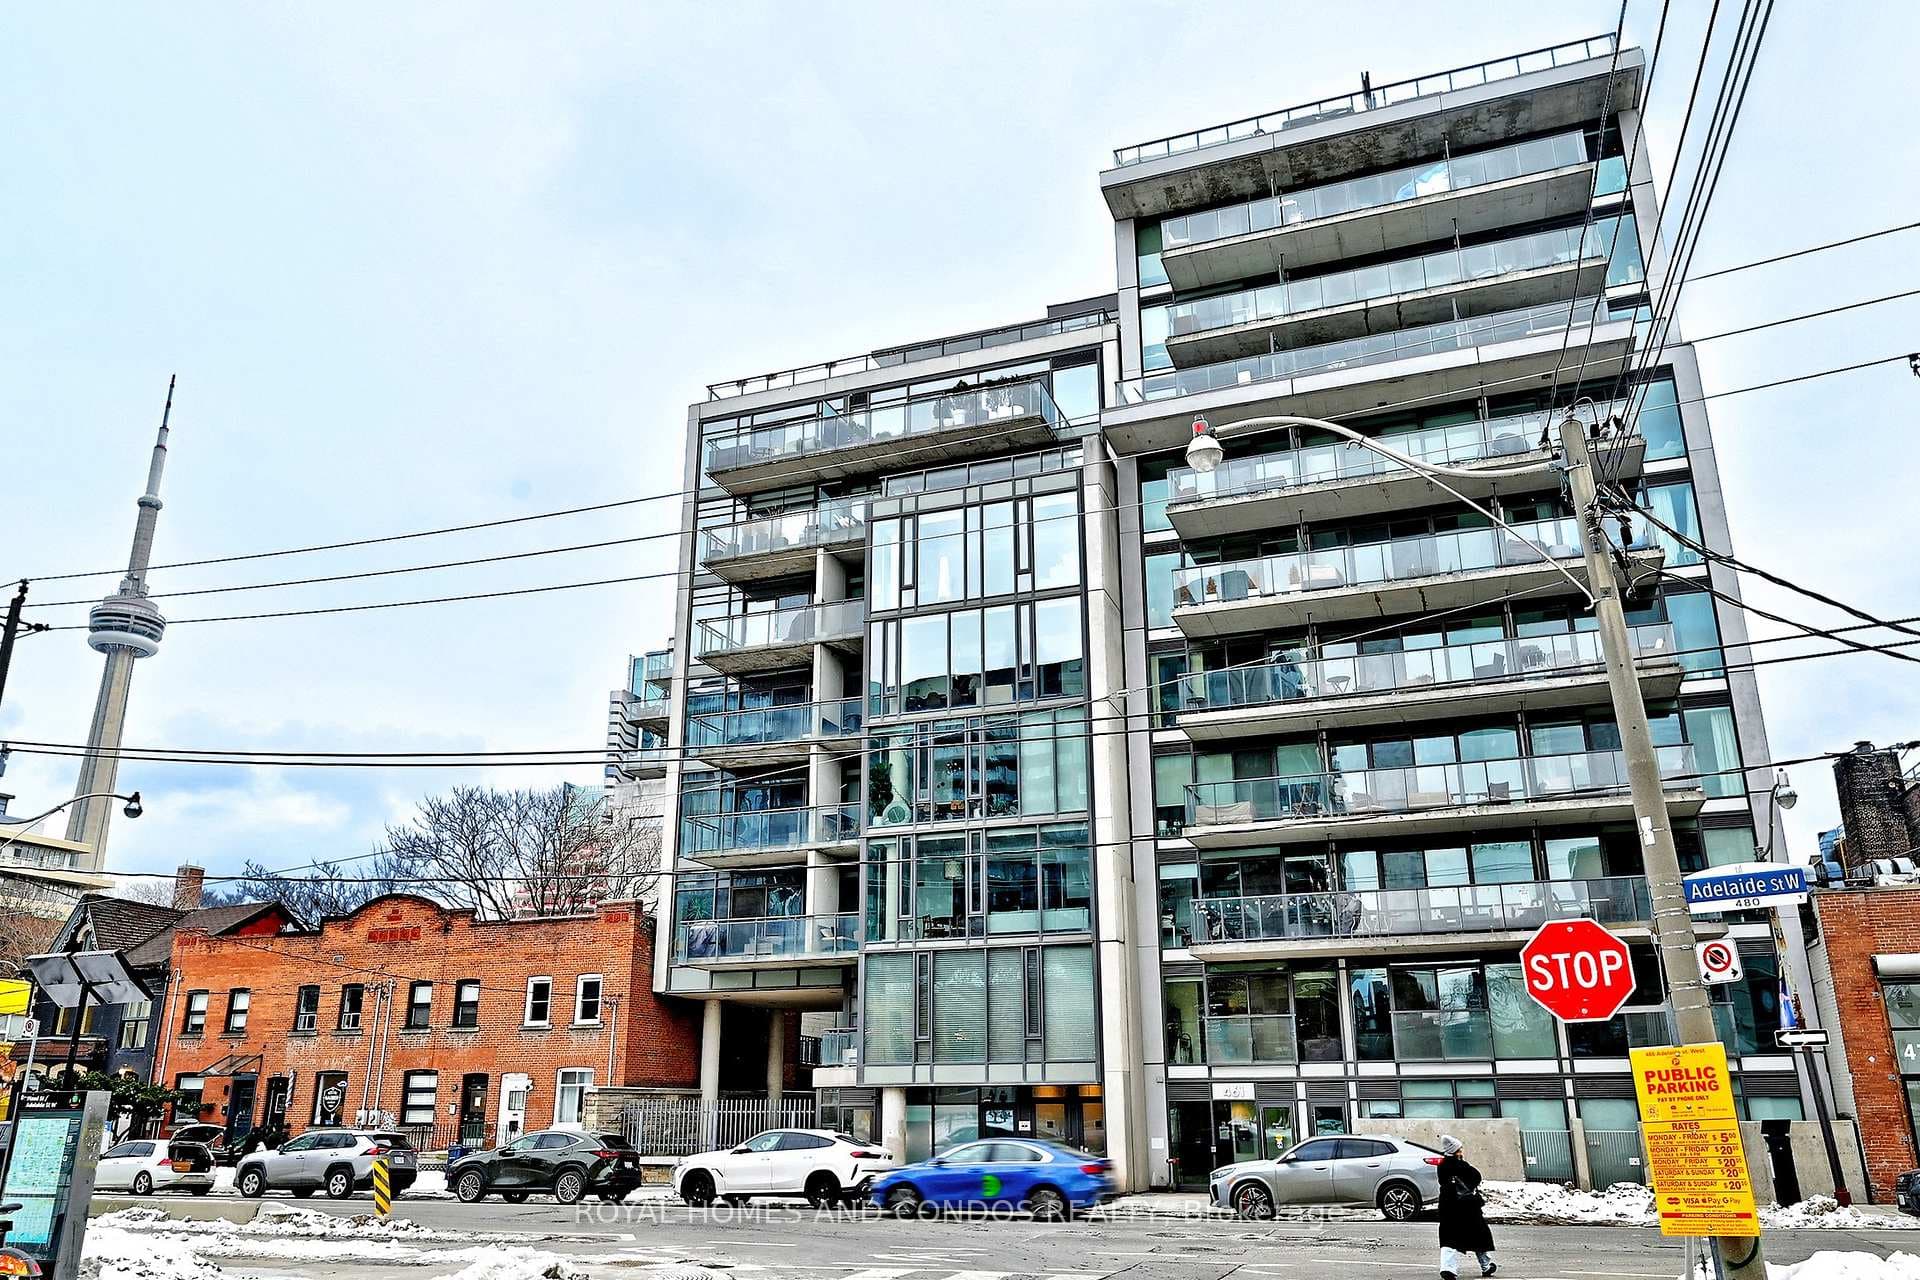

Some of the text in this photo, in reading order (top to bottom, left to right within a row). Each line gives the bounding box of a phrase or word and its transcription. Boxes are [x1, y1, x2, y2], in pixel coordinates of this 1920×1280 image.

[1692, 873, 1800, 899] Adelaide St W
[1736, 898, 1760, 907] 480
[1530, 950, 1623, 991] STOP
[1903, 1043, 1920, 1060] 4
[1645, 1066, 1717, 1082] PUBLIC
[1224, 1086, 1246, 1098] 461
[1647, 1080, 1719, 1095] PARKING
[1672, 1122, 1700, 1130] RATES
[1707, 1196, 1721, 1205] Pay
